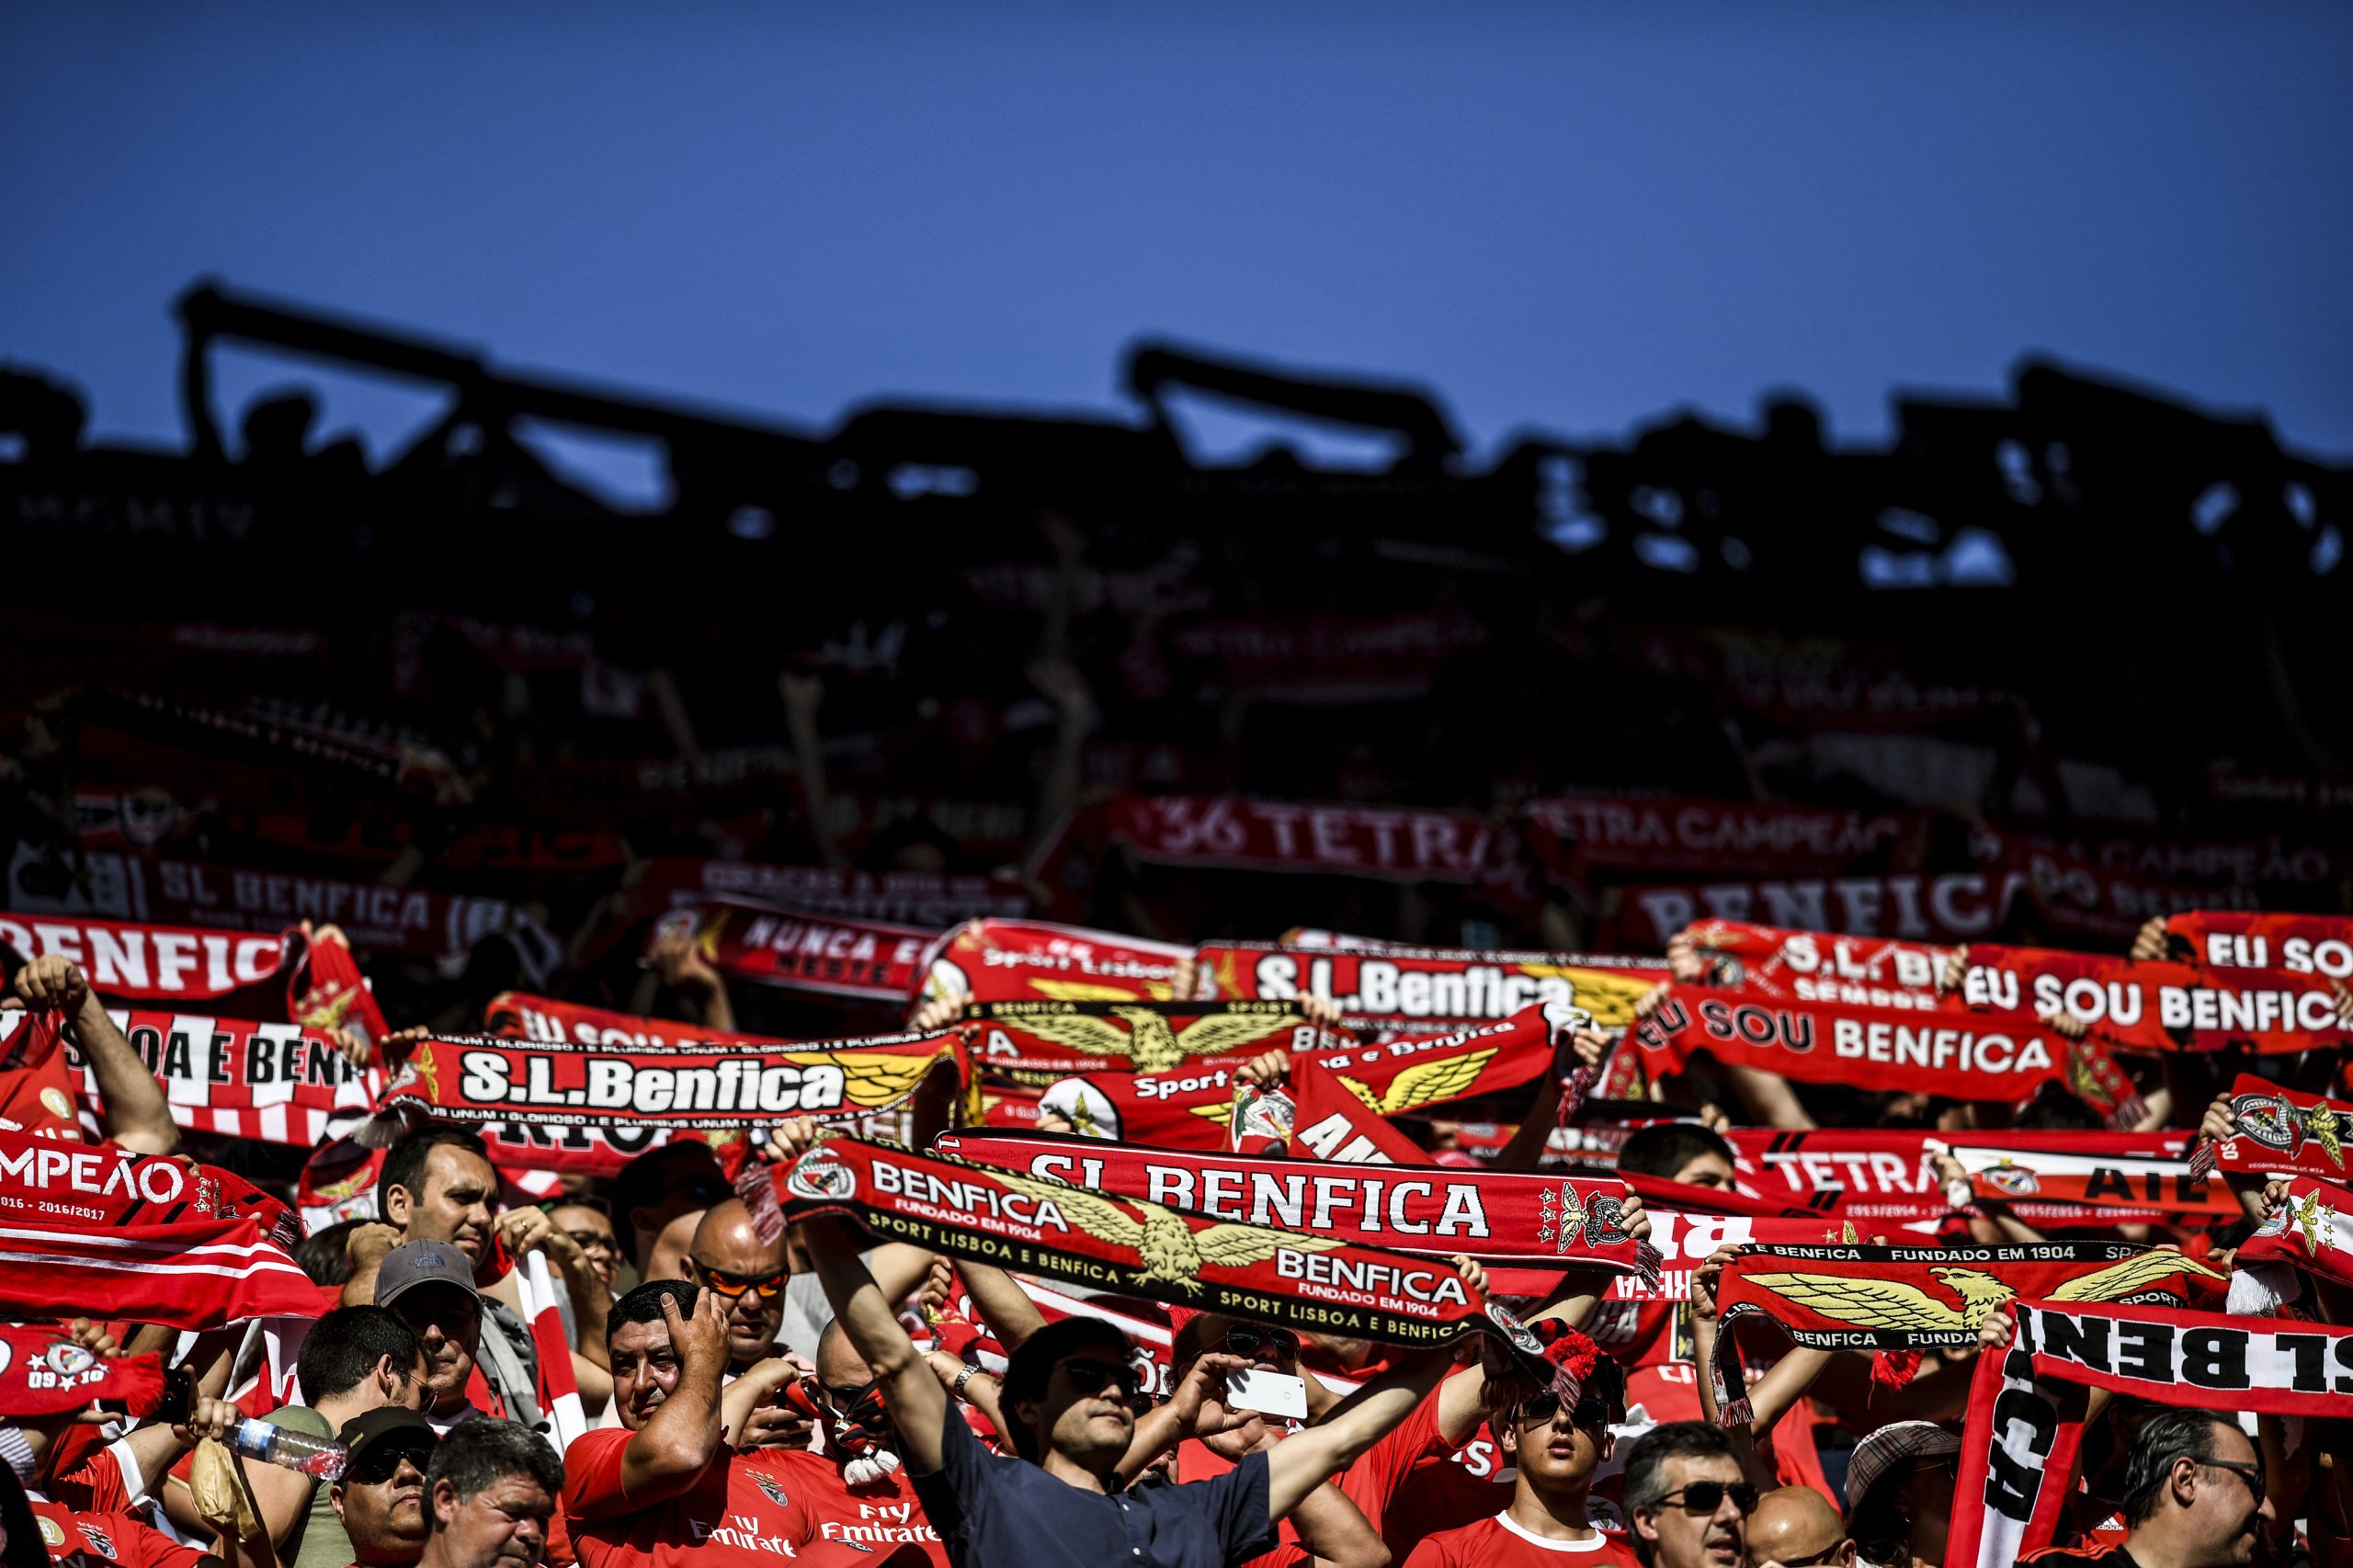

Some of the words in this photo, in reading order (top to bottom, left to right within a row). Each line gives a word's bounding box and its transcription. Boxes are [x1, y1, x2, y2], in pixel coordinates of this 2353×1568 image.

[741, 914, 878, 961] NUNCA
[2208, 932, 2268, 968] EU
[992, 1002, 1078, 1016] BENFICA
[1227, 1002, 1292, 1014] SPORT
[1965, 966, 2019, 1010] EU
[2034, 974, 2142, 1027] SOU
[495, 1040, 574, 1051] GLORIOSO
[741, 1041, 821, 1054] GLORIOSO
[847, 1030, 922, 1048] PLURIBUS
[1361, 1051, 1381, 1062] e
[1386, 1019, 1517, 1057] Benfica
[1699, 999, 1815, 1053] SOU
[1834, 1017, 2052, 1074] BENFICA
[208, 1030, 233, 1085] E
[244, 1033, 357, 1088] BEN
[461, 1051, 845, 1115] S.L.Benfica
[1132, 1069, 1229, 1101] Sport
[450, 1108, 496, 1120] UNUM
[508, 1112, 586, 1124] GLORIOSO
[598, 1117, 610, 1125] E
[613, 1118, 688, 1129] PLURIBUS
[692, 1119, 740, 1129] UNUM
[38, 1200, 106, 1221] 2016/2017
[871, 1159, 1071, 1233] BENFICA
[1145, 1165, 1491, 1238] BENFICA
[894, 1199, 979, 1227] FUNDADO
[981, 1217, 1007, 1233] EM
[1007, 1222, 1042, 1242] 1904
[869, 1211, 931, 1240] SPORT
[940, 1231, 1012, 1260] LISBOA
[1021, 1249, 1030, 1264] E
[1039, 1253, 1120, 1285] BENFICA
[1756, 1244, 1768, 1253] E
[1774, 1245, 1861, 1260] BENFICA
[1891, 1247, 1993, 1261] FUNDADO
[1997, 1247, 2024, 1260] EM
[2029, 1245, 2076, 1260] 1904
[1277, 1246, 1468, 1306] BENFICA
[1220, 1290, 1281, 1315] SPORT
[1290, 1303, 1361, 1329] LISBOA
[1370, 1316, 1379, 1331] E
[1298, 1282, 1376, 1305] FUNDADO
[1380, 1296, 1403, 1311] EM
[1404, 1300, 1438, 1317] 1904
[2119, 1291, 2177, 1307] SPORT
[1792, 1330, 1878, 1346] BENFICA
[28, 1371, 56, 1389] 09
[81, 1369, 105, 1384] 10
[730, 1515, 758, 1535] ly
[858, 1503, 911, 1524] Fly
